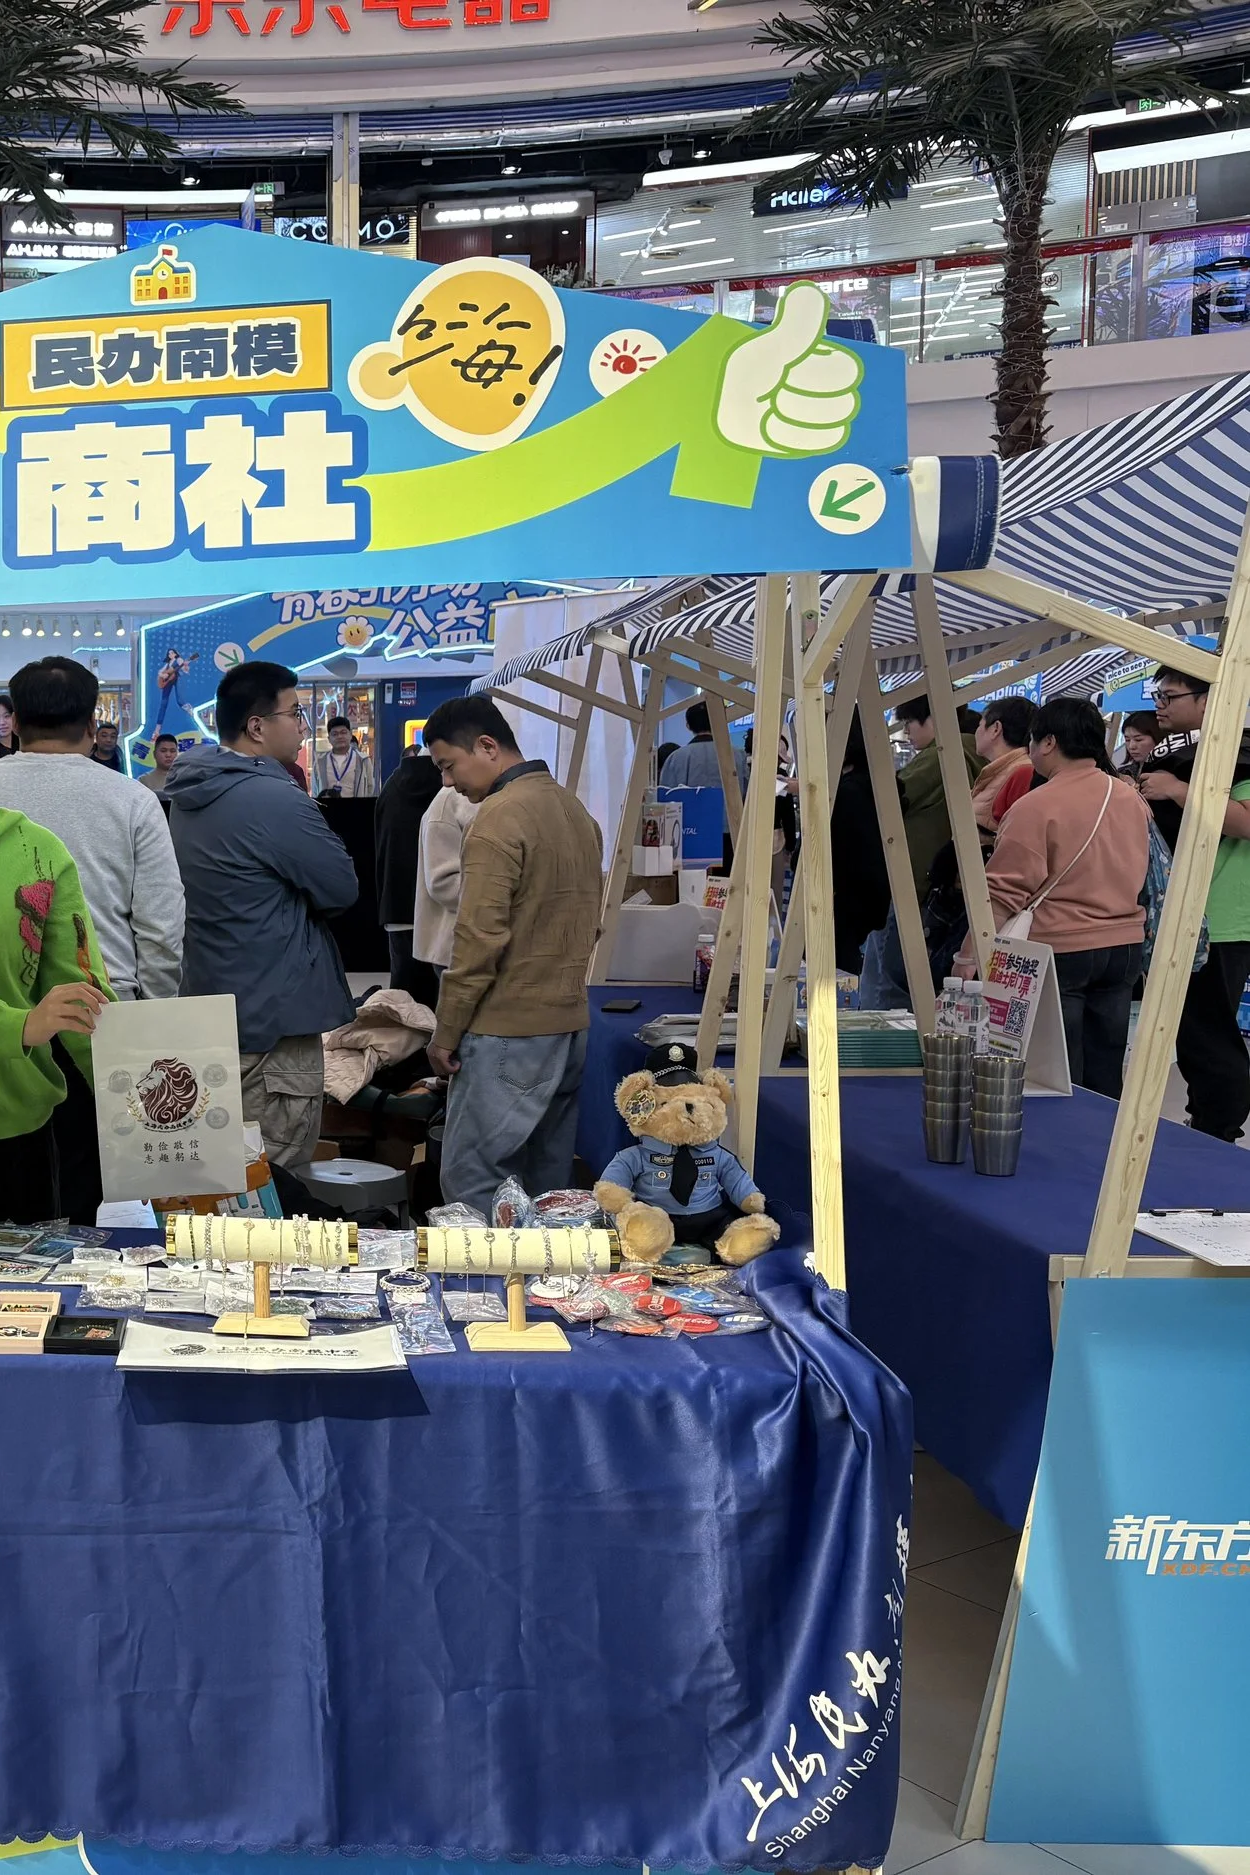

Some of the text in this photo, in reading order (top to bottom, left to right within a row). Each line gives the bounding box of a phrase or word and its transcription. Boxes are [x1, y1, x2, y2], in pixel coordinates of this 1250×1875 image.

[289, 219, 394, 241] COMO
[31, 321, 300, 390] 民办南模
[16, 409, 357, 558] 商社
[384, 599, 486, 651] 公益
[1105, 1515, 1250, 1575] 新东方
[765, 1677, 902, 1859] Shanghai Nanyang
